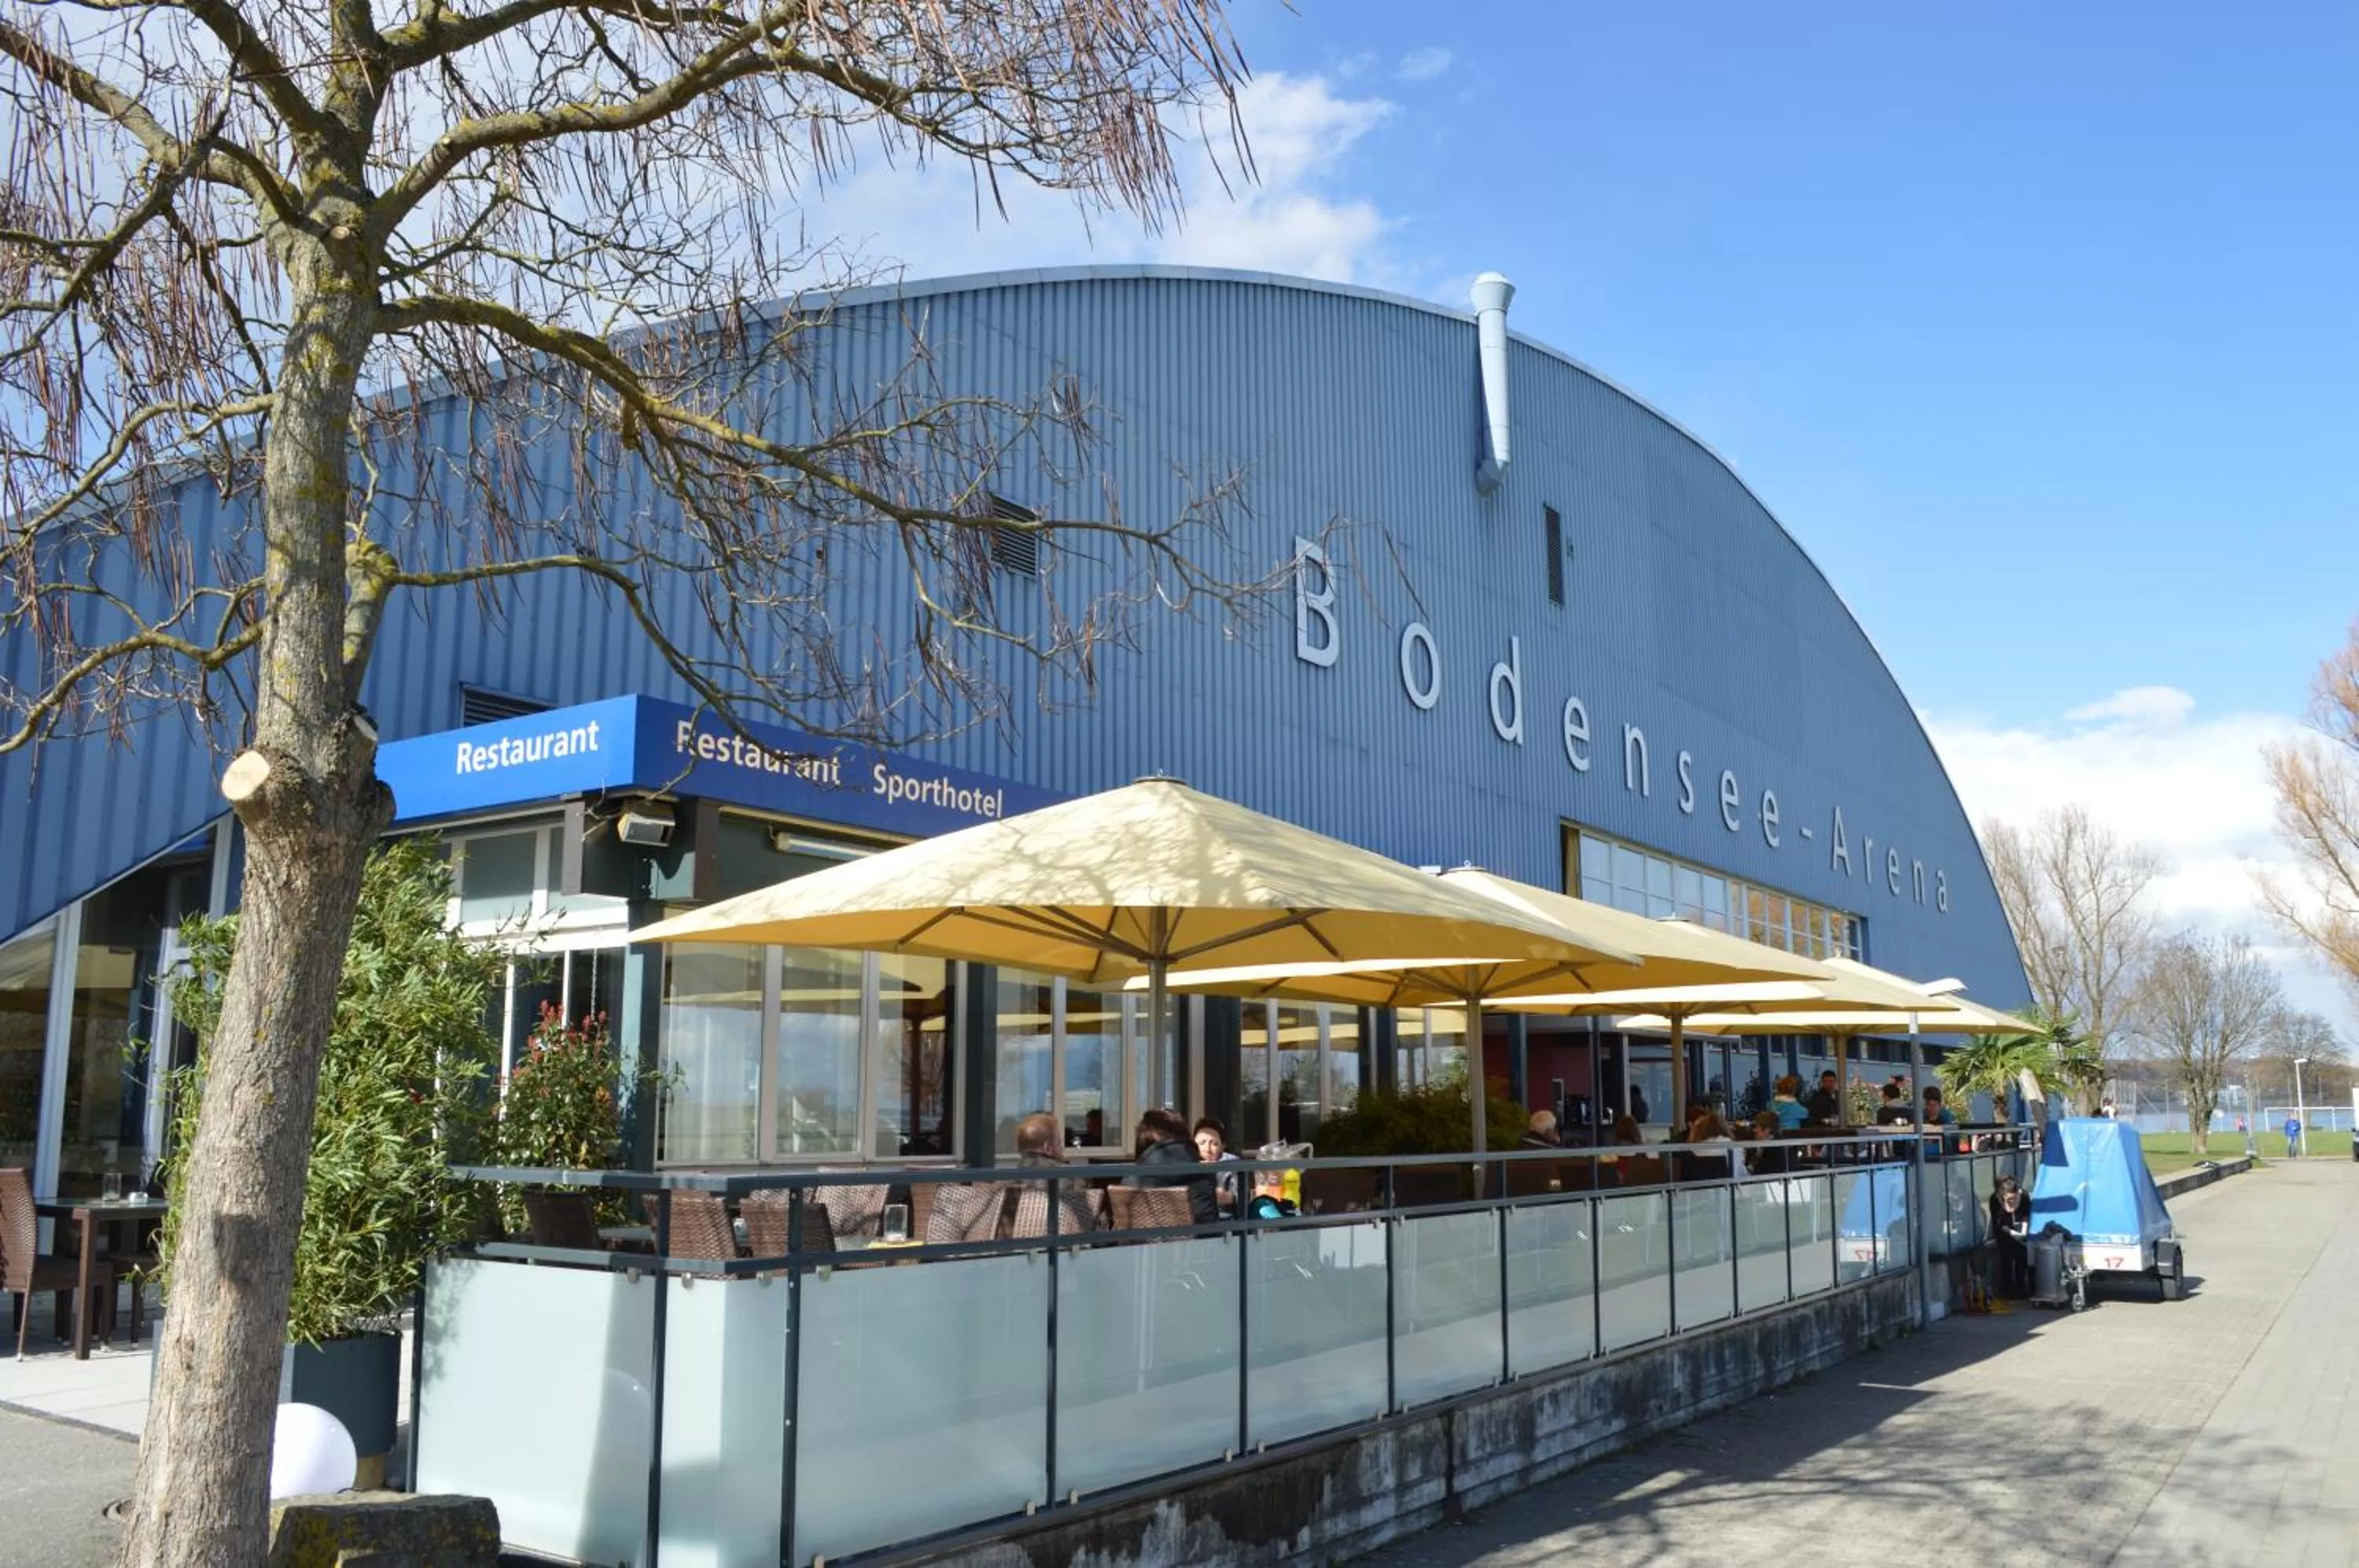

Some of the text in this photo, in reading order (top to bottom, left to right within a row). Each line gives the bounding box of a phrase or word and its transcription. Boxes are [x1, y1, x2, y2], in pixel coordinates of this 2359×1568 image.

[456, 720, 599, 775] Restaurant
[1294, 535, 1948, 913] Bodensee-Arena
[676, 720, 1003, 819] Restaurant Sporthotel
[2104, 1257, 2125, 1268] 17
